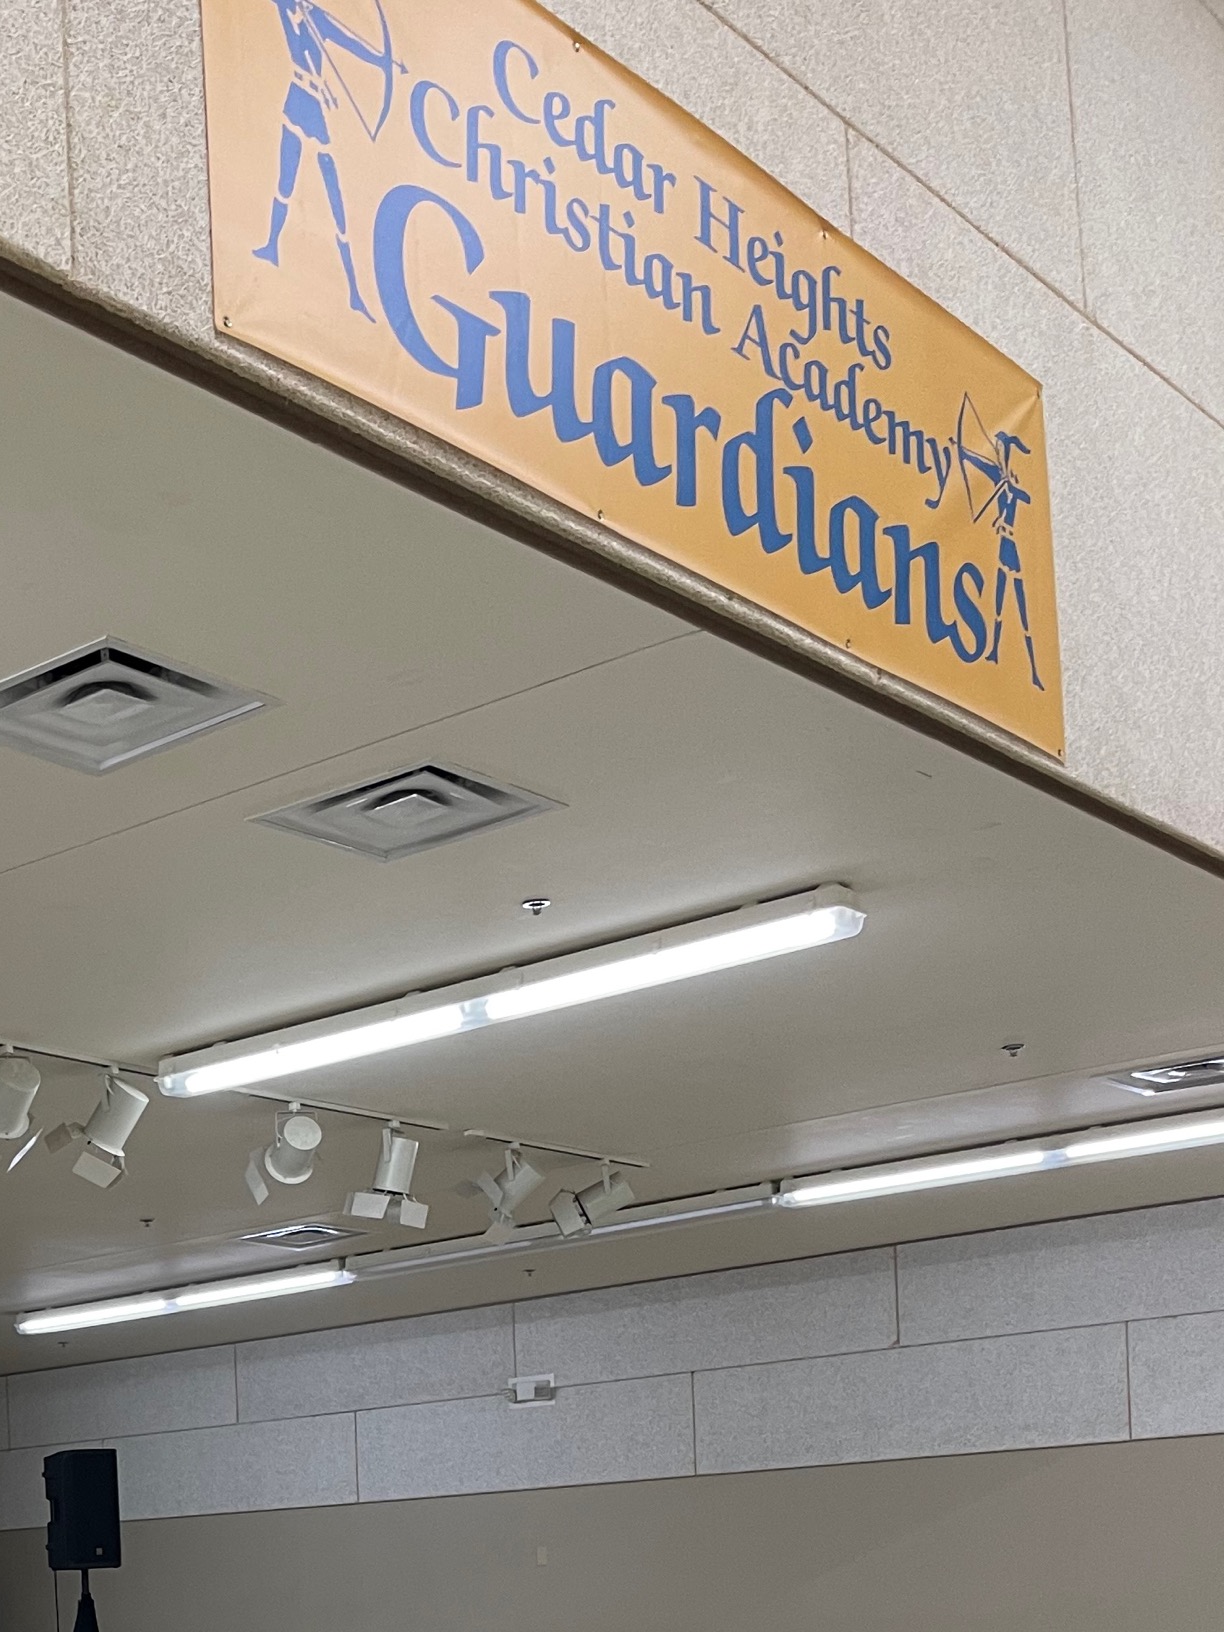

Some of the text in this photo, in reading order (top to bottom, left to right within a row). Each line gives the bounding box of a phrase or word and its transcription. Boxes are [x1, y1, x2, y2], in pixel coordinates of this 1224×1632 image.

[409, 79, 951, 509] Christian Academy
[492, 40, 891, 370] Cedar Heights
[373, 183, 986, 663] Guardians
